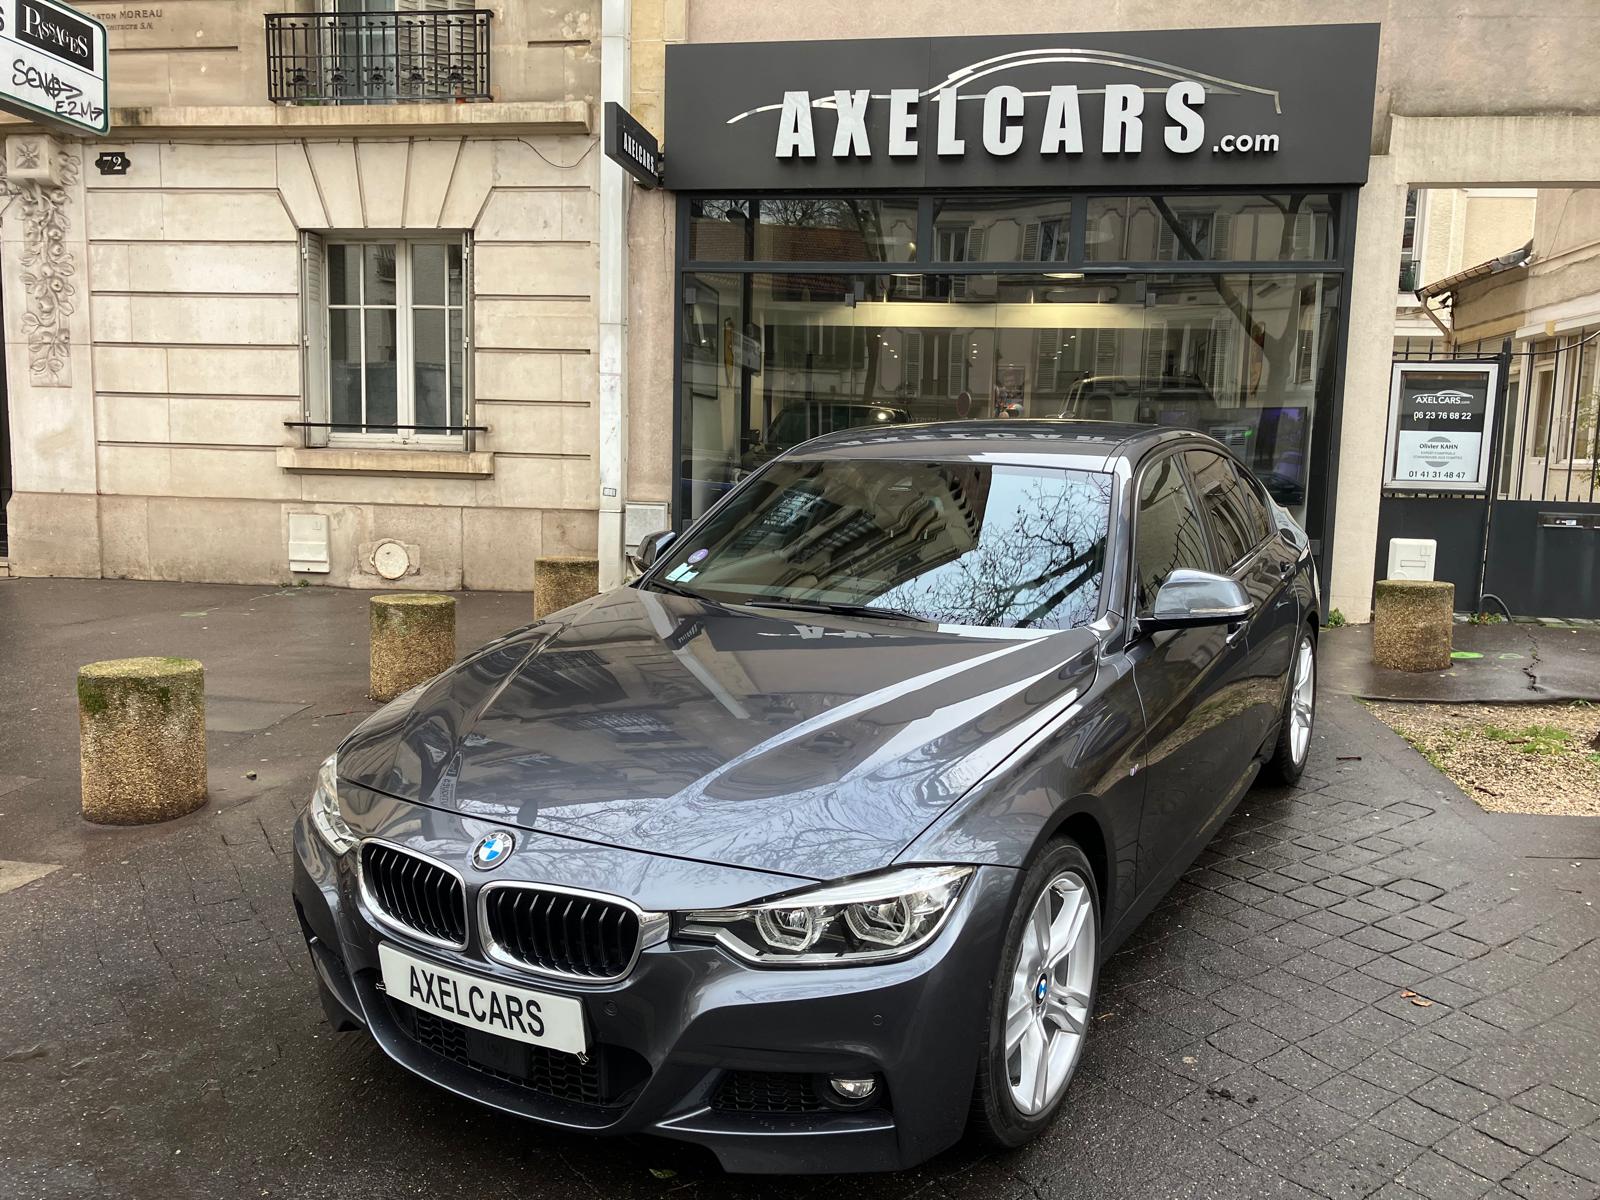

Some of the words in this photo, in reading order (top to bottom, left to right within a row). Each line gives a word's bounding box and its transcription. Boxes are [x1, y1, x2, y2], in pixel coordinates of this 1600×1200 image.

[119, 9, 163, 19] MOREAU
[102, 156, 123, 170] 72
[1413, 411, 1424, 420] 06
[1425, 411, 1436, 420] 23
[1438, 411, 1448, 420] 76
[1449, 411, 1460, 420] 68
[1461, 412, 1472, 420] 22
[1408, 470, 1418, 478] 01
[1420, 470, 1430, 478] 41
[1443, 471, 1454, 479] 48
[1455, 471, 1466, 479] 47
[409, 964, 545, 1038] AXELCARS
